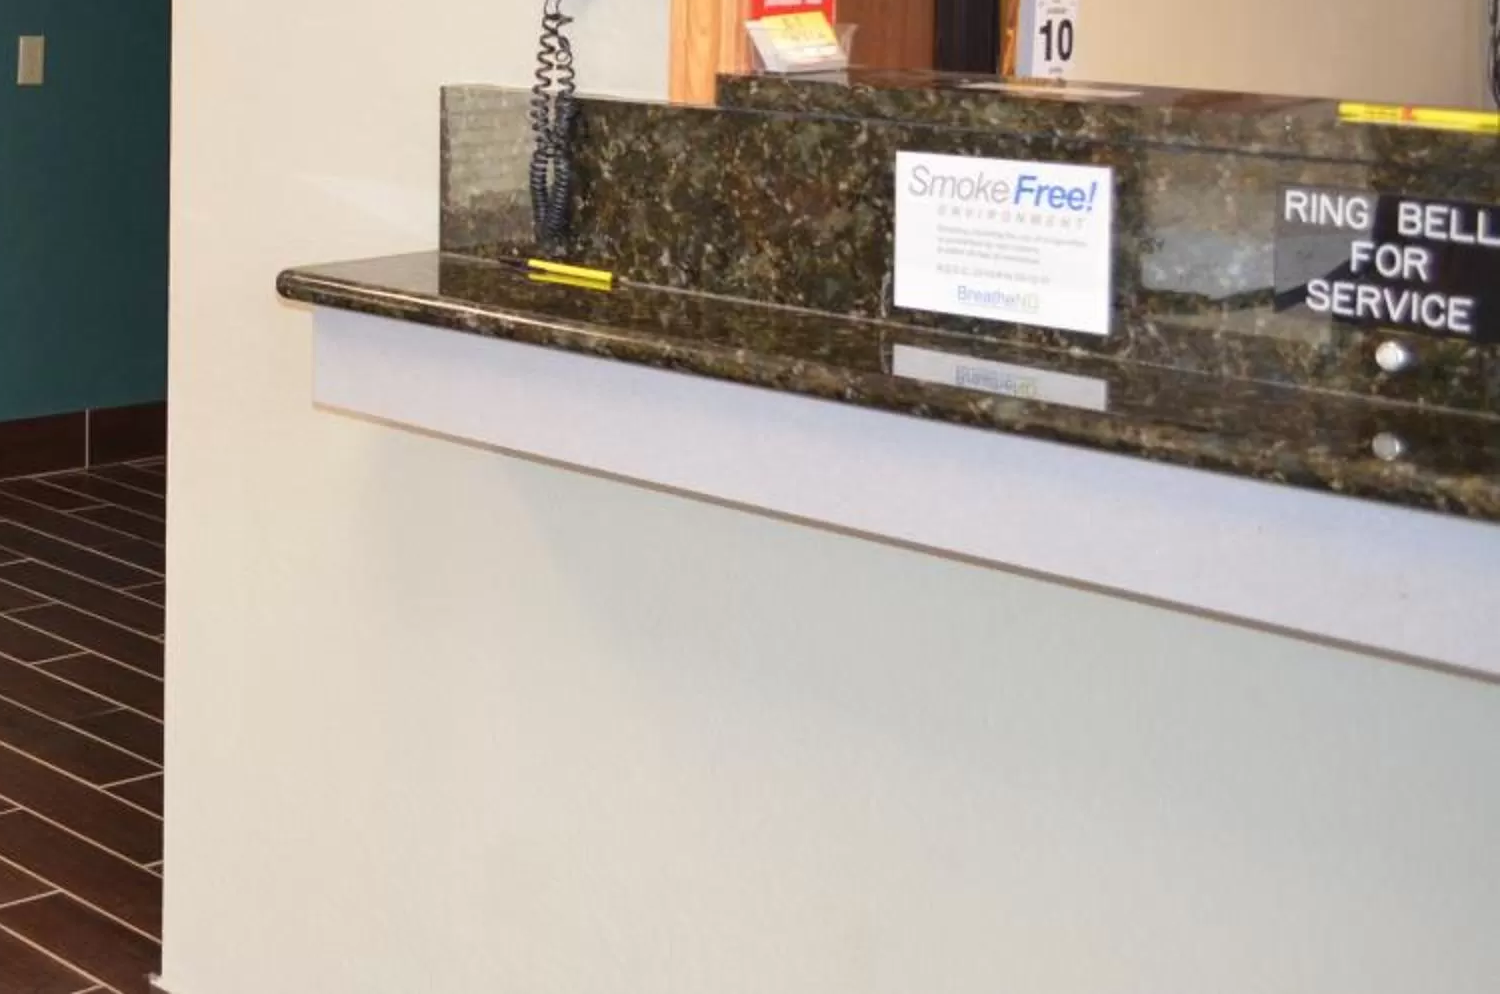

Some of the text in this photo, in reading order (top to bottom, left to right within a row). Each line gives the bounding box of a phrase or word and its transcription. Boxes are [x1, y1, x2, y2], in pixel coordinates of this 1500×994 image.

[1039, 18, 1074, 62] 10
[908, 164, 1098, 212] Smoke Free!
[1283, 189, 1500, 247] RING BELL
[1351, 239, 1430, 281] FOR
[1305, 278, 1474, 333] SERVICE
